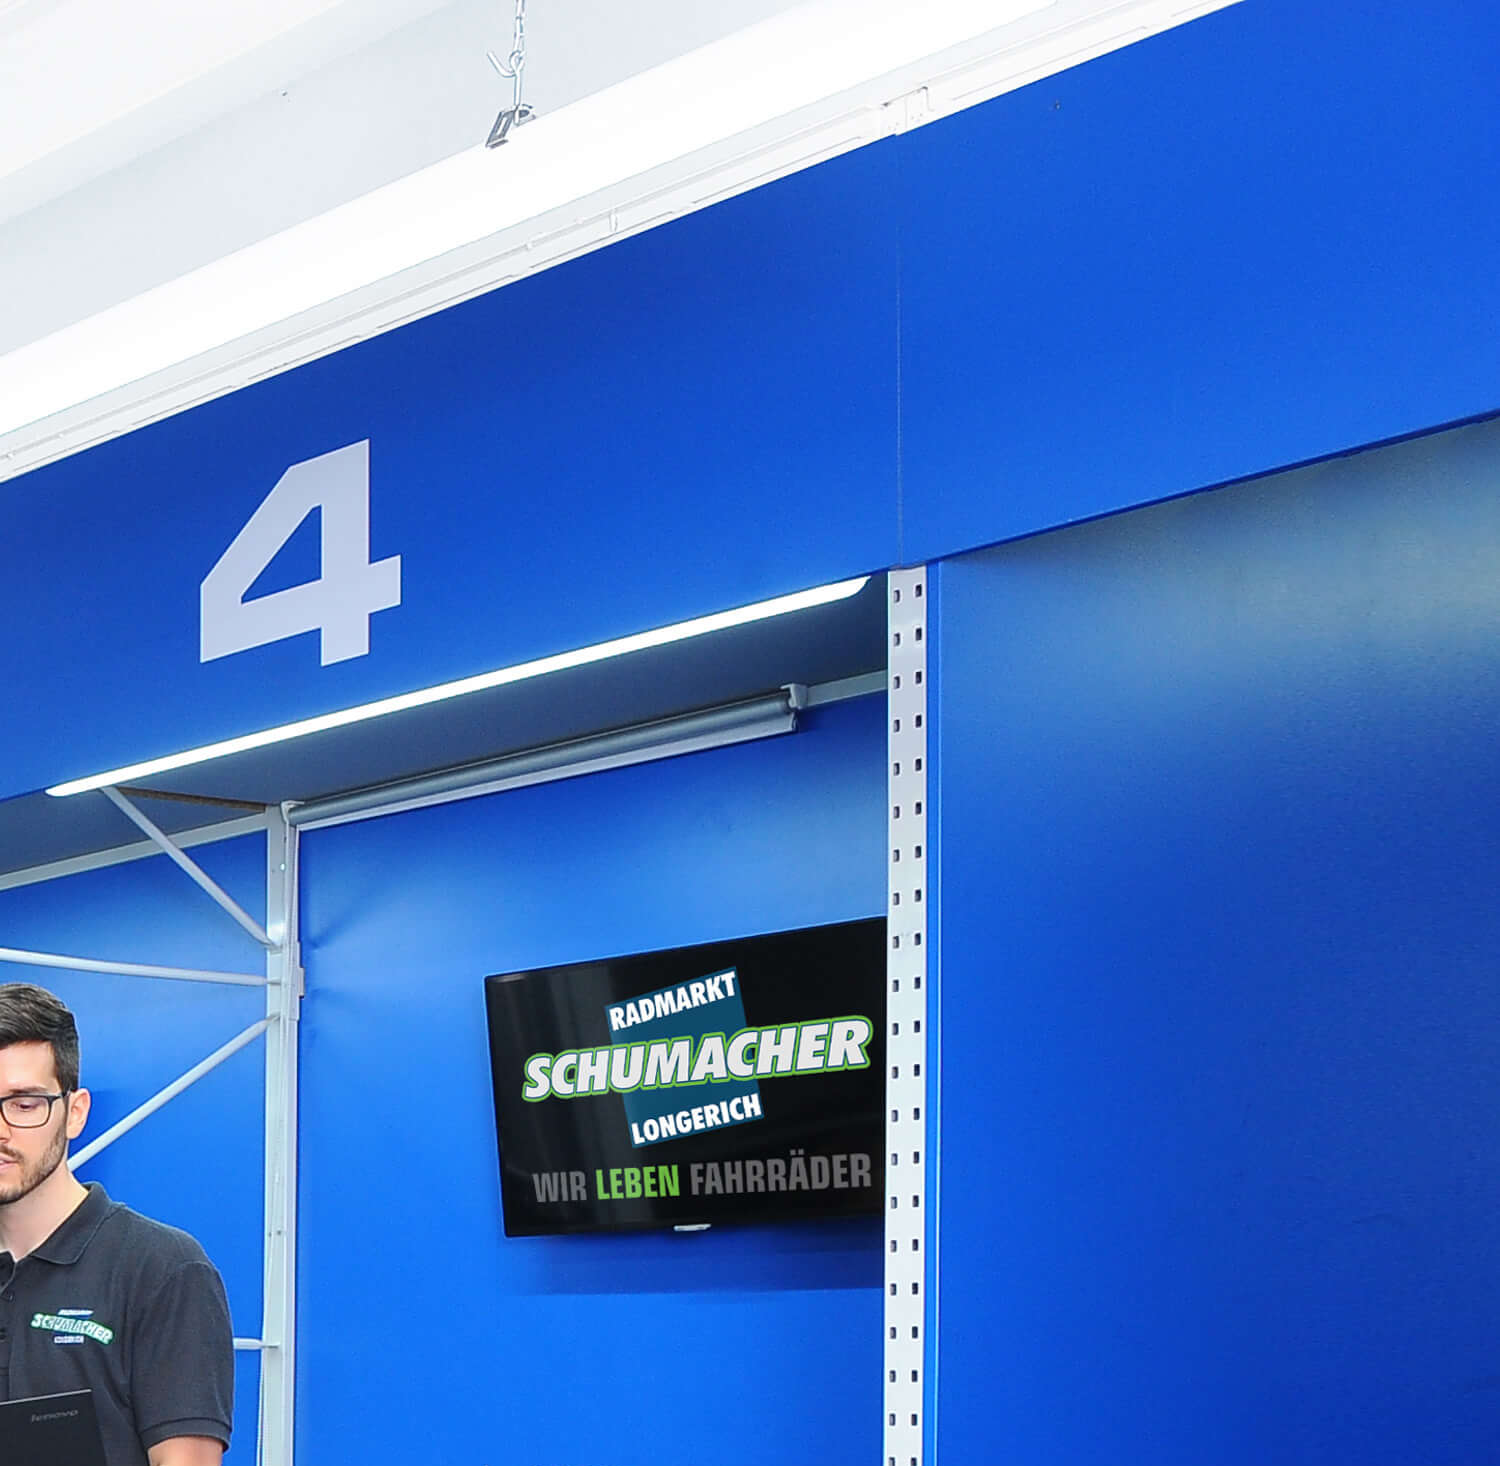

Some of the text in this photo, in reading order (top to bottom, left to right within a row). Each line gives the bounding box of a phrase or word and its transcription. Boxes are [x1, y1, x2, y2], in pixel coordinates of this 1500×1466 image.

[200, 438, 401, 667] 4
[609, 970, 737, 1032] RADMARKT
[523, 1017, 872, 1100] SCHUMACHER
[631, 1094, 762, 1146] LONGERICH
[532, 1150, 873, 1203] WIR LEBEN FAHRRÄDER
